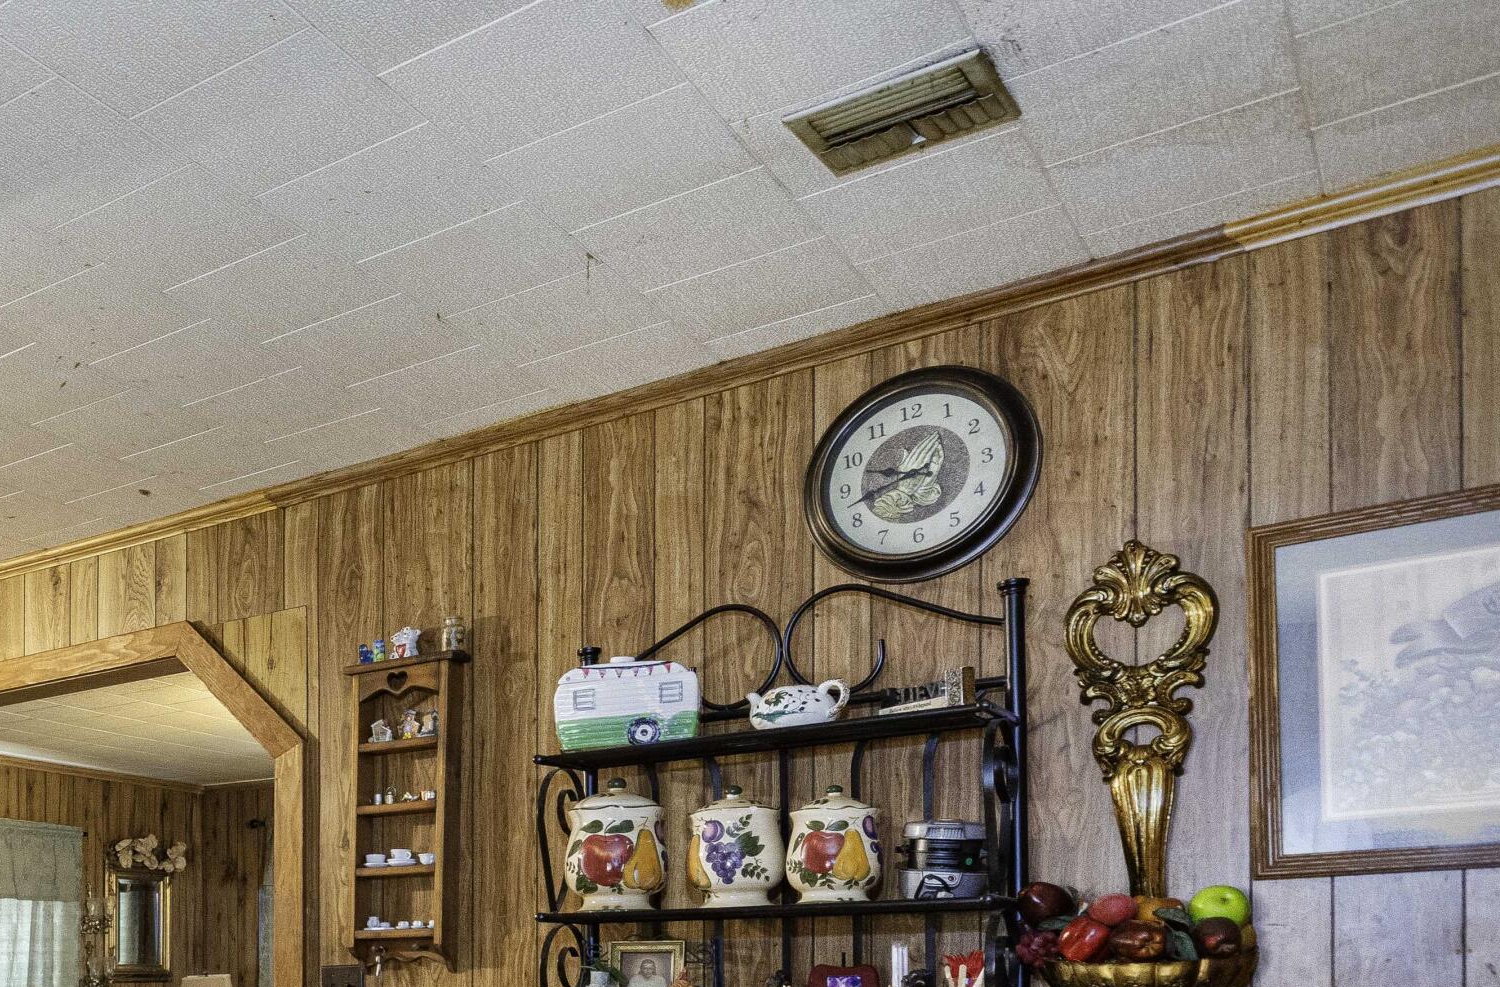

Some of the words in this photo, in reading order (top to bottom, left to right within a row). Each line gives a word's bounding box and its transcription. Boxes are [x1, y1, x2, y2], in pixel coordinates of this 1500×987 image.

[900, 403, 923, 422] 12
[943, 403, 953, 418] 1
[867, 422, 886, 440] 11
[968, 419, 980, 434] 2
[843, 452, 863, 469] 10
[981, 447, 994, 464] 3
[840, 484, 851, 499] 9
[973, 480, 985, 496] 4
[852, 512, 863, 528] 8
[950, 512, 961, 527] 5
[877, 529, 889, 545] 7
[913, 527, 925, 543] 6
